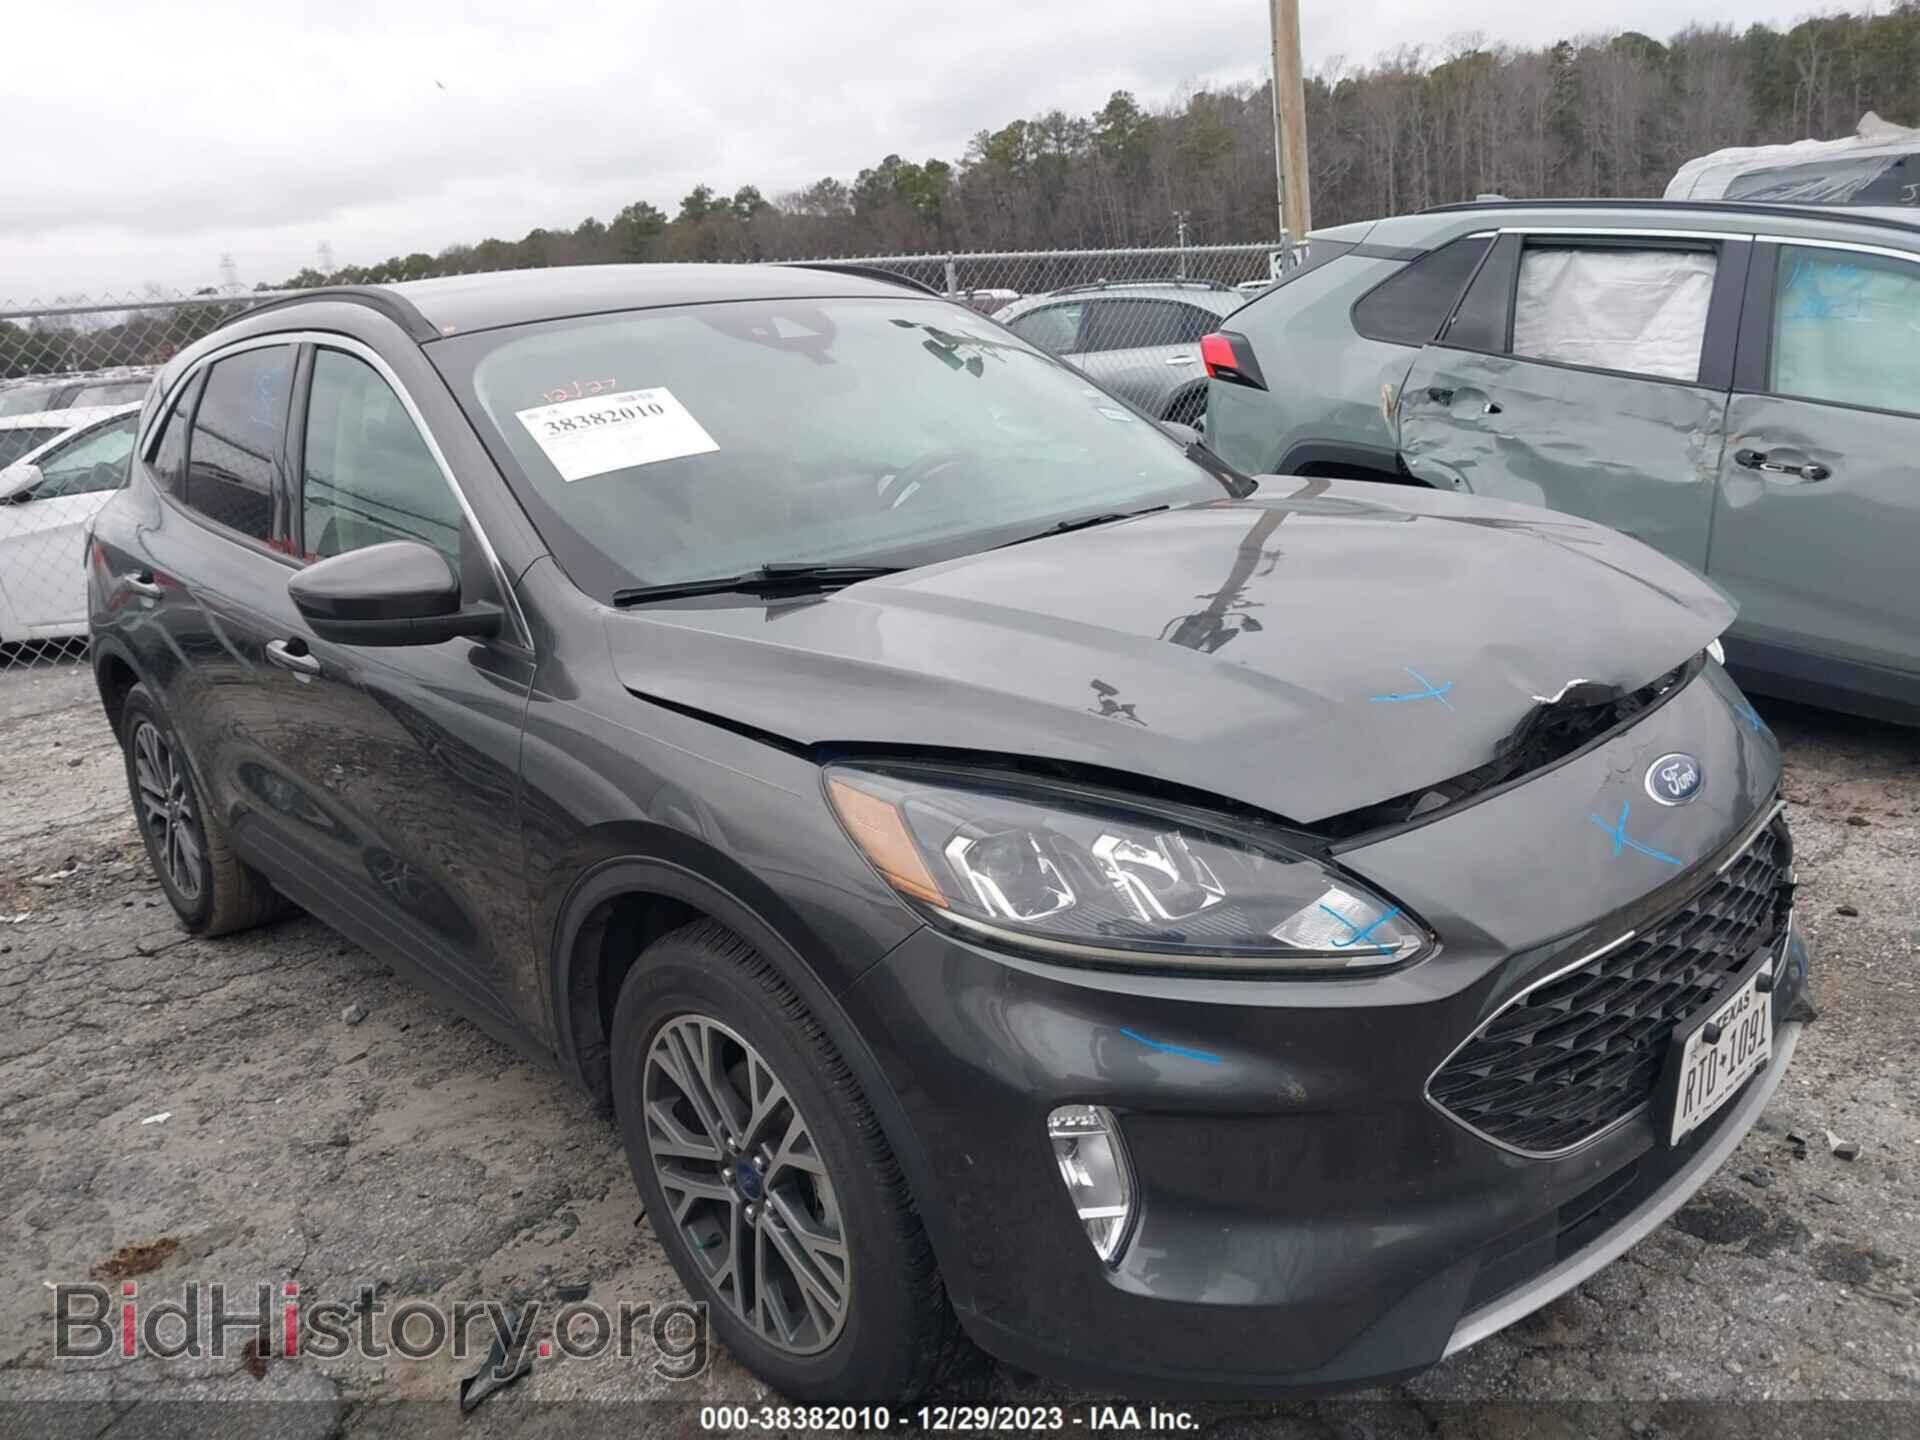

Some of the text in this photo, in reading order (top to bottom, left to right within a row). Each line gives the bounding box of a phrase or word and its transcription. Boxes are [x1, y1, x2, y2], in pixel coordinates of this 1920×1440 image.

[544, 403, 665, 436] 38382010
[1661, 763, 1696, 795] Ford
[1715, 990, 1750, 1029] TEXAS
